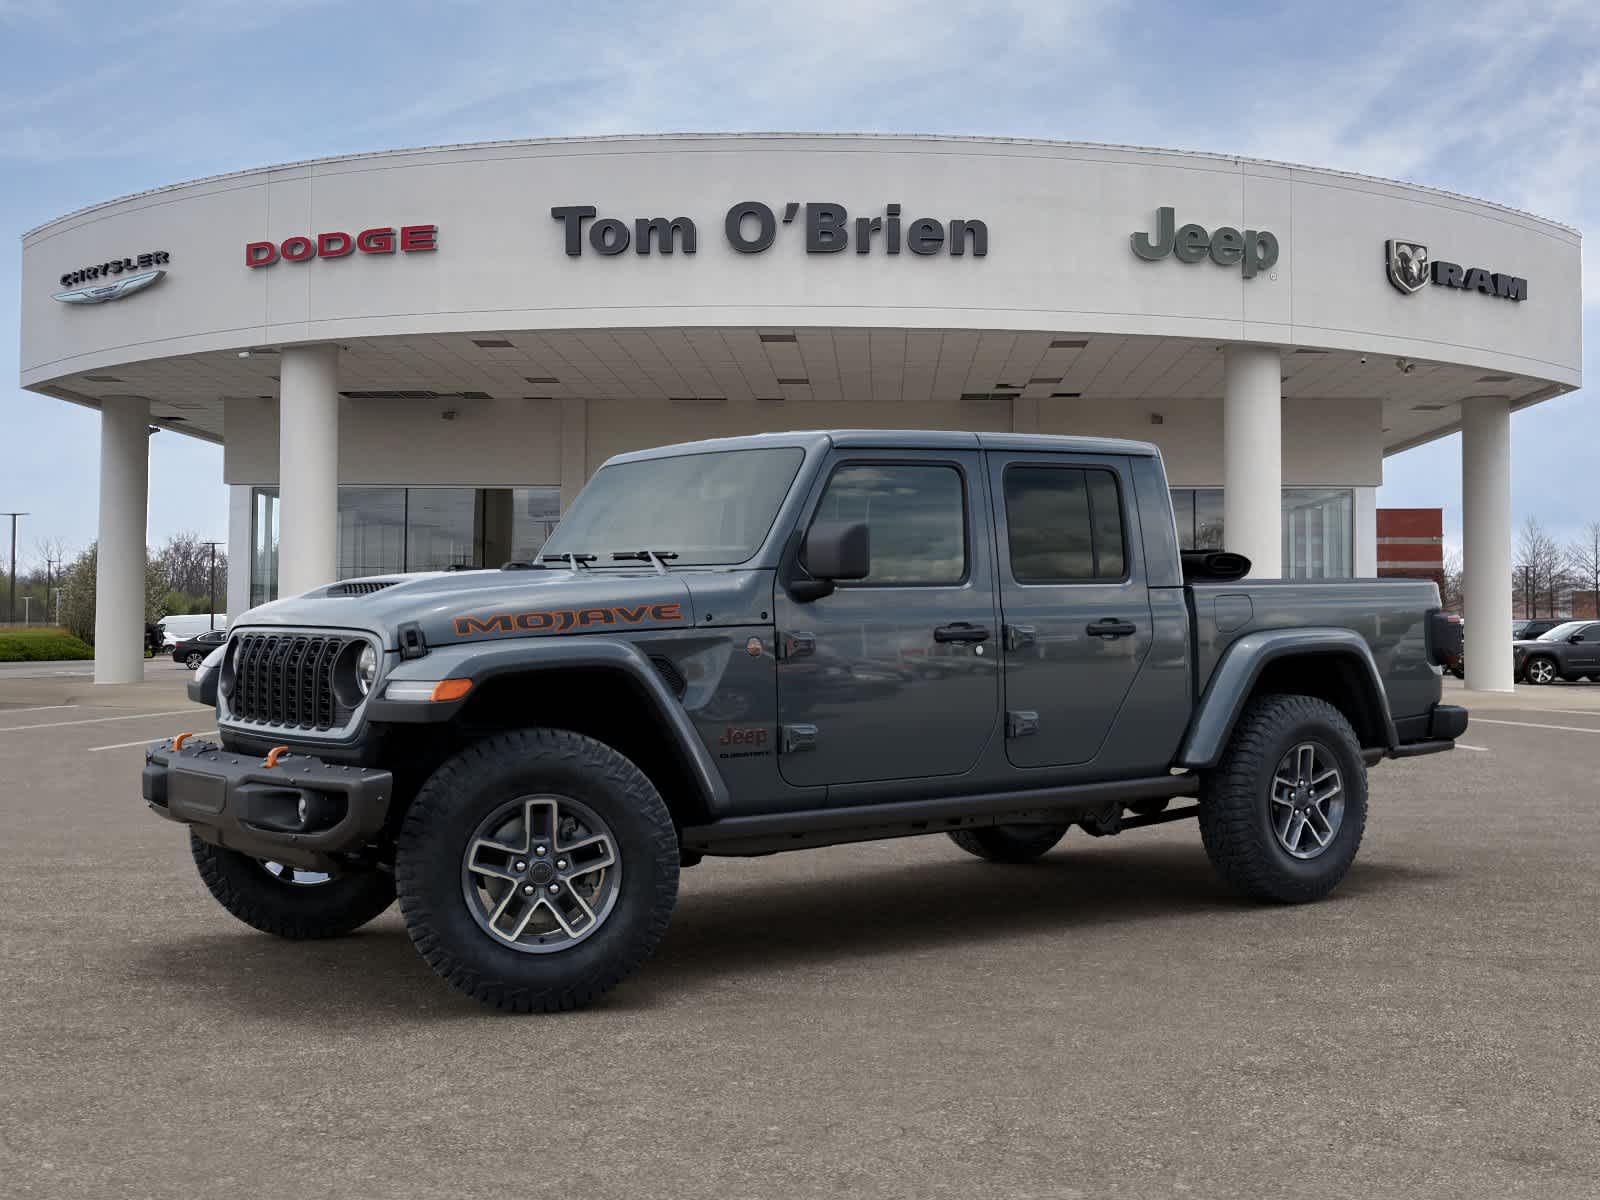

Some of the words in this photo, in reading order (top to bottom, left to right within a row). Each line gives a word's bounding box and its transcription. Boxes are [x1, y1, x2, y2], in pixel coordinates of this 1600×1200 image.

[245, 225, 439, 269] DODGE
[551, 206, 697, 256] Tom
[725, 201, 988, 256] O'Brien
[1130, 207, 1280, 279] Jeep
[60, 250, 170, 287] CHRYSLER
[1431, 260, 1528, 301] RAM
[453, 603, 683, 636] MOJAVE
[719, 726, 769, 748] Jeep
